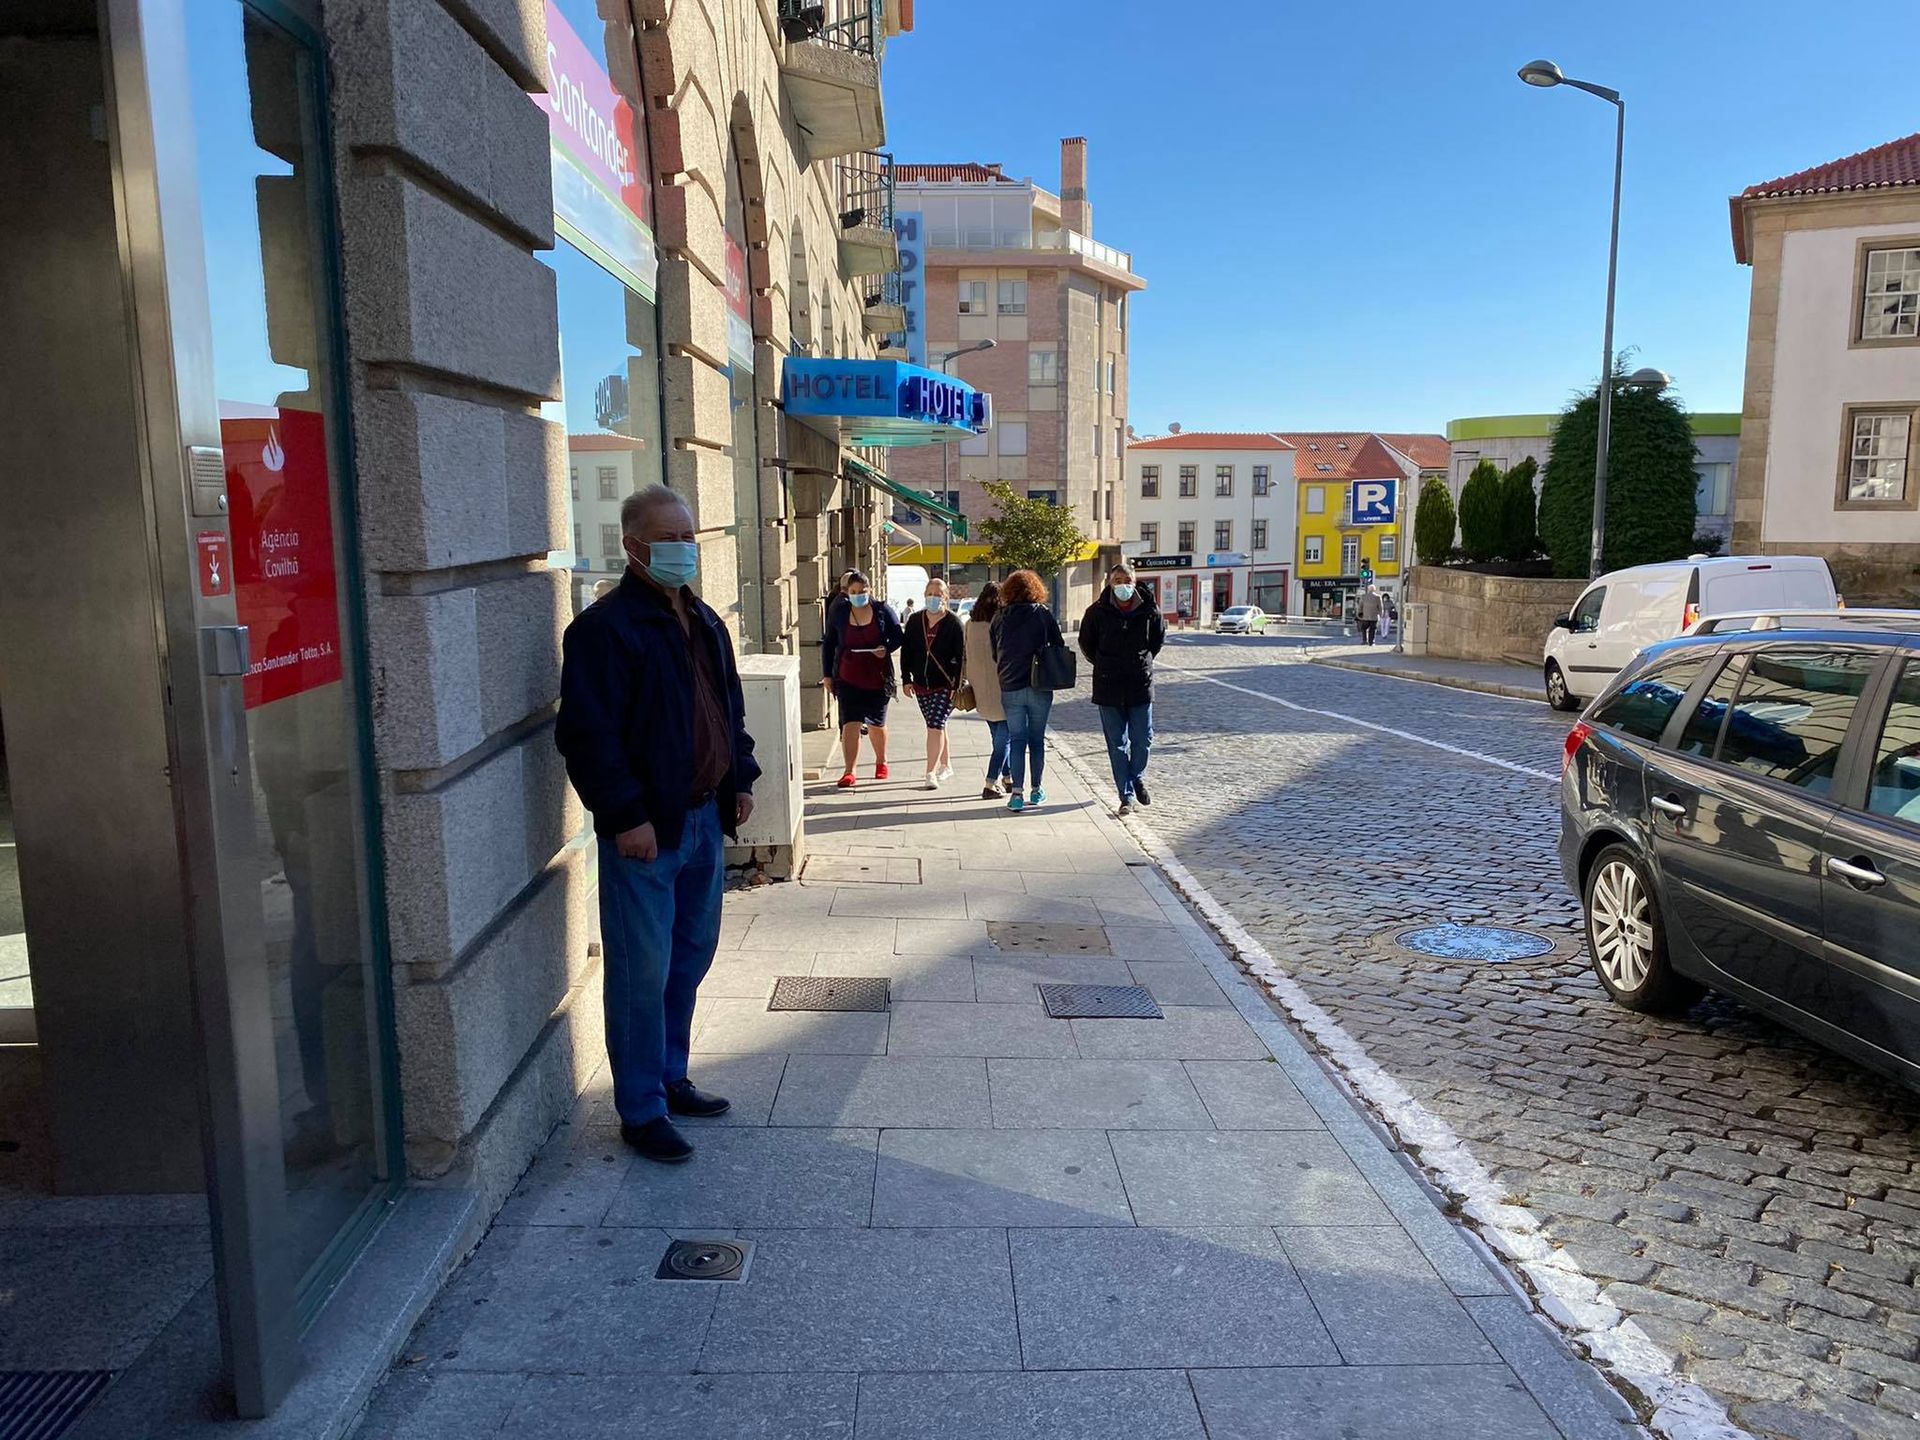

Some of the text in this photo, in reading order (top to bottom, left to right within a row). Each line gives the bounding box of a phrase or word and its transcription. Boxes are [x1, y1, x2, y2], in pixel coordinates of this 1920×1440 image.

[547, 40, 629, 187] Santander
[894, 218, 917, 362] HOTE
[790, 373, 890, 400] HOTEL
[920, 376, 971, 421] HOTEL
[1358, 484, 1387, 511] P
[261, 529, 299, 553] Agência
[265, 556, 299, 578] Covilhã
[262, 652, 299, 671] Santander
